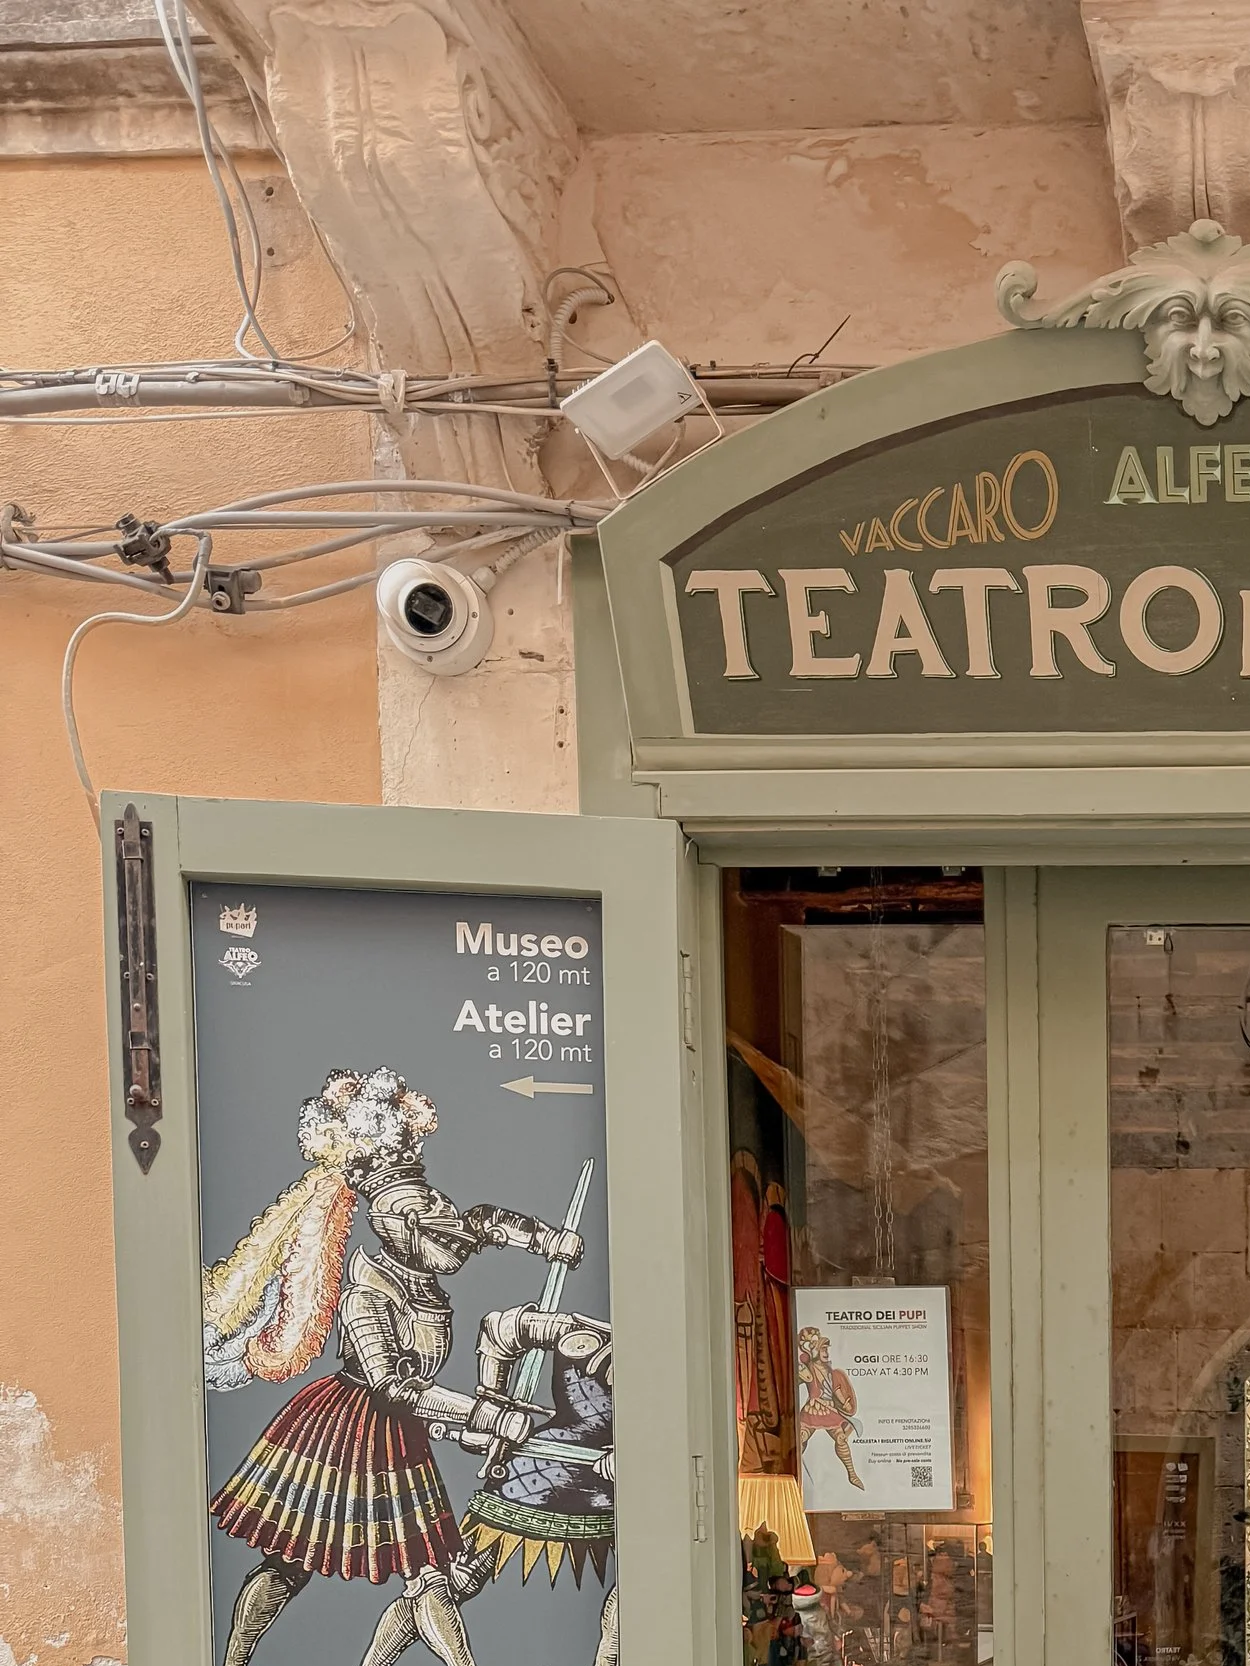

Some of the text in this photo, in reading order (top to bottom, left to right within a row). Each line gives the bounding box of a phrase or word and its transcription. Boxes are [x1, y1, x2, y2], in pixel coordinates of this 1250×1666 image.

[839, 450, 1059, 556] VACCARO
[684, 564, 1224, 679] TEATRO
[455, 921, 589, 960] Museo
[223, 950, 258, 961] ALFEO
[487, 962, 591, 985] a 120 mt
[453, 1000, 592, 1036] Atelier
[489, 1039, 593, 1062] a 120 mt
[825, 1309, 927, 1321] TEATRO DEI PUPI
[854, 1354, 929, 1363] OGGI ORE 16:30
[847, 1367, 929, 1377] TODAY AT 4:30 PM
